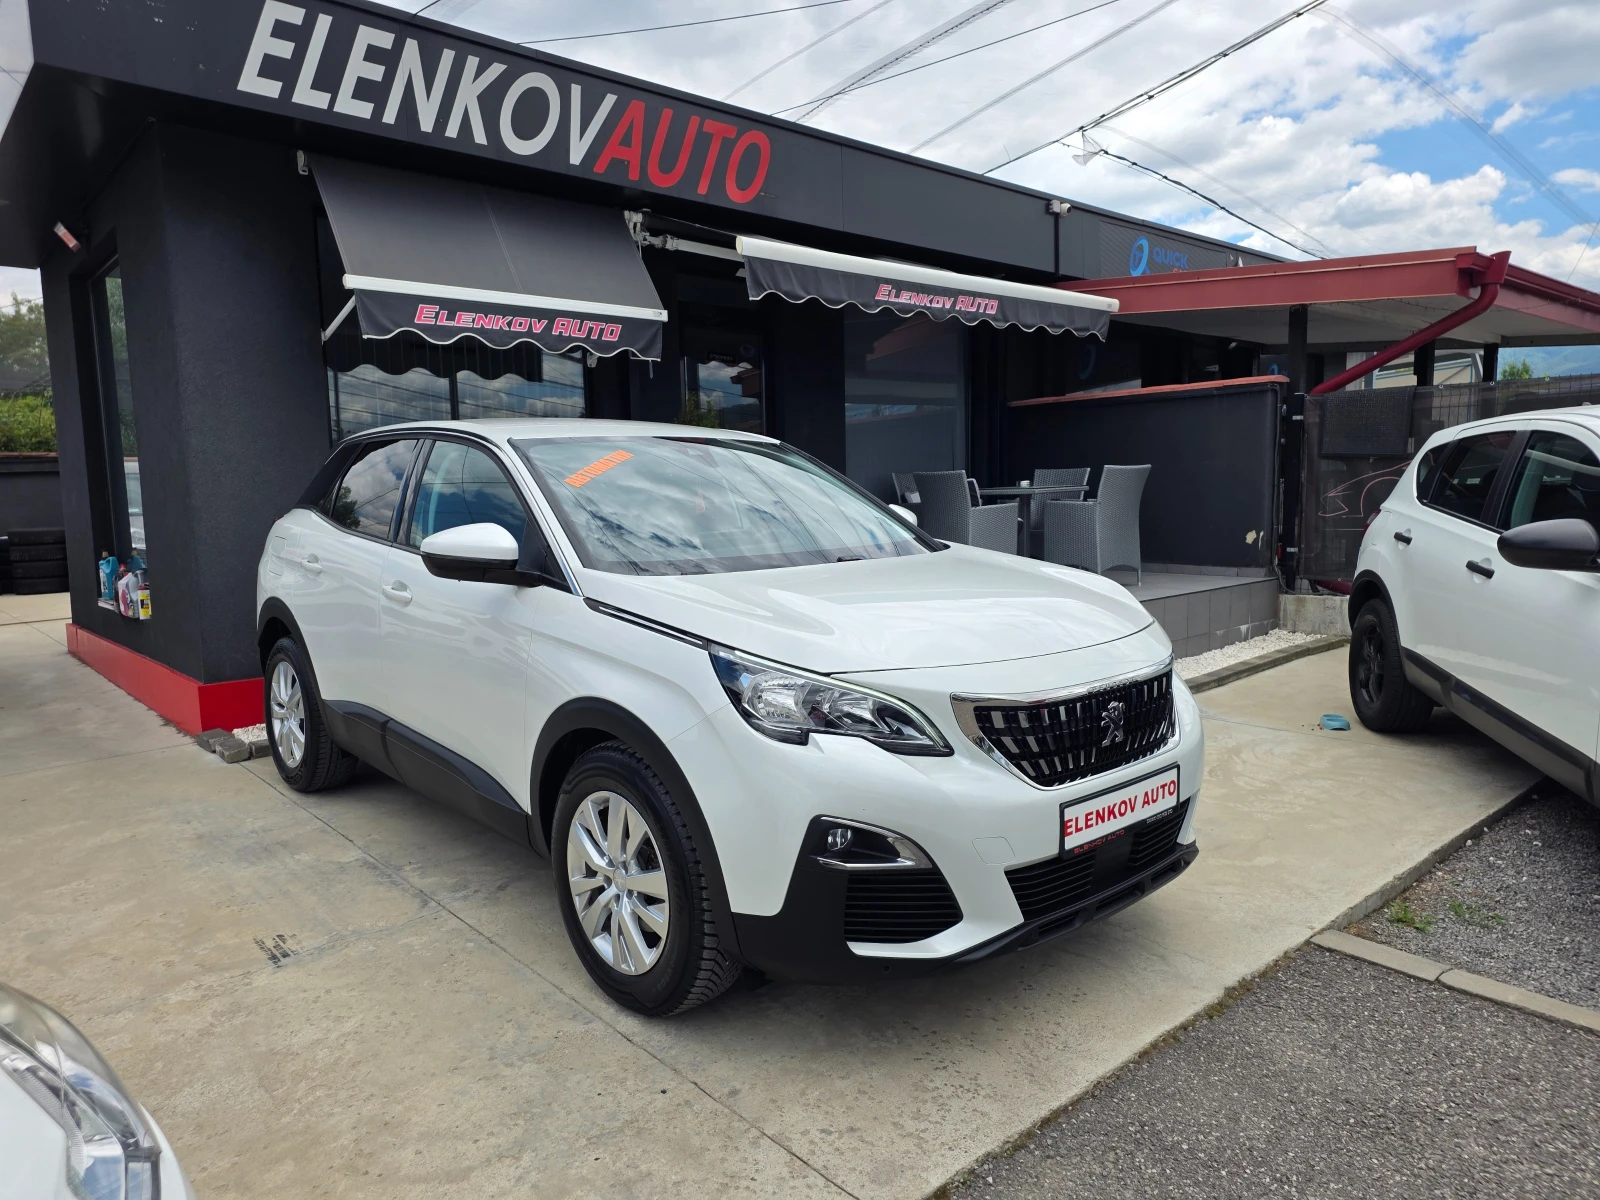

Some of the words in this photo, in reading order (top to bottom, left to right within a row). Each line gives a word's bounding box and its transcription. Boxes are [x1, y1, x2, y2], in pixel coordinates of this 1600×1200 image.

[1153, 247, 1189, 270] QUICK
[875, 284, 954, 309] ELENKOV
[955, 295, 998, 314] AUTO
[414, 304, 548, 333] ELENKOV
[552, 317, 622, 341] AUTO
[1064, 795, 1138, 837] ELENKOV
[1141, 779, 1177, 809] AUTO
